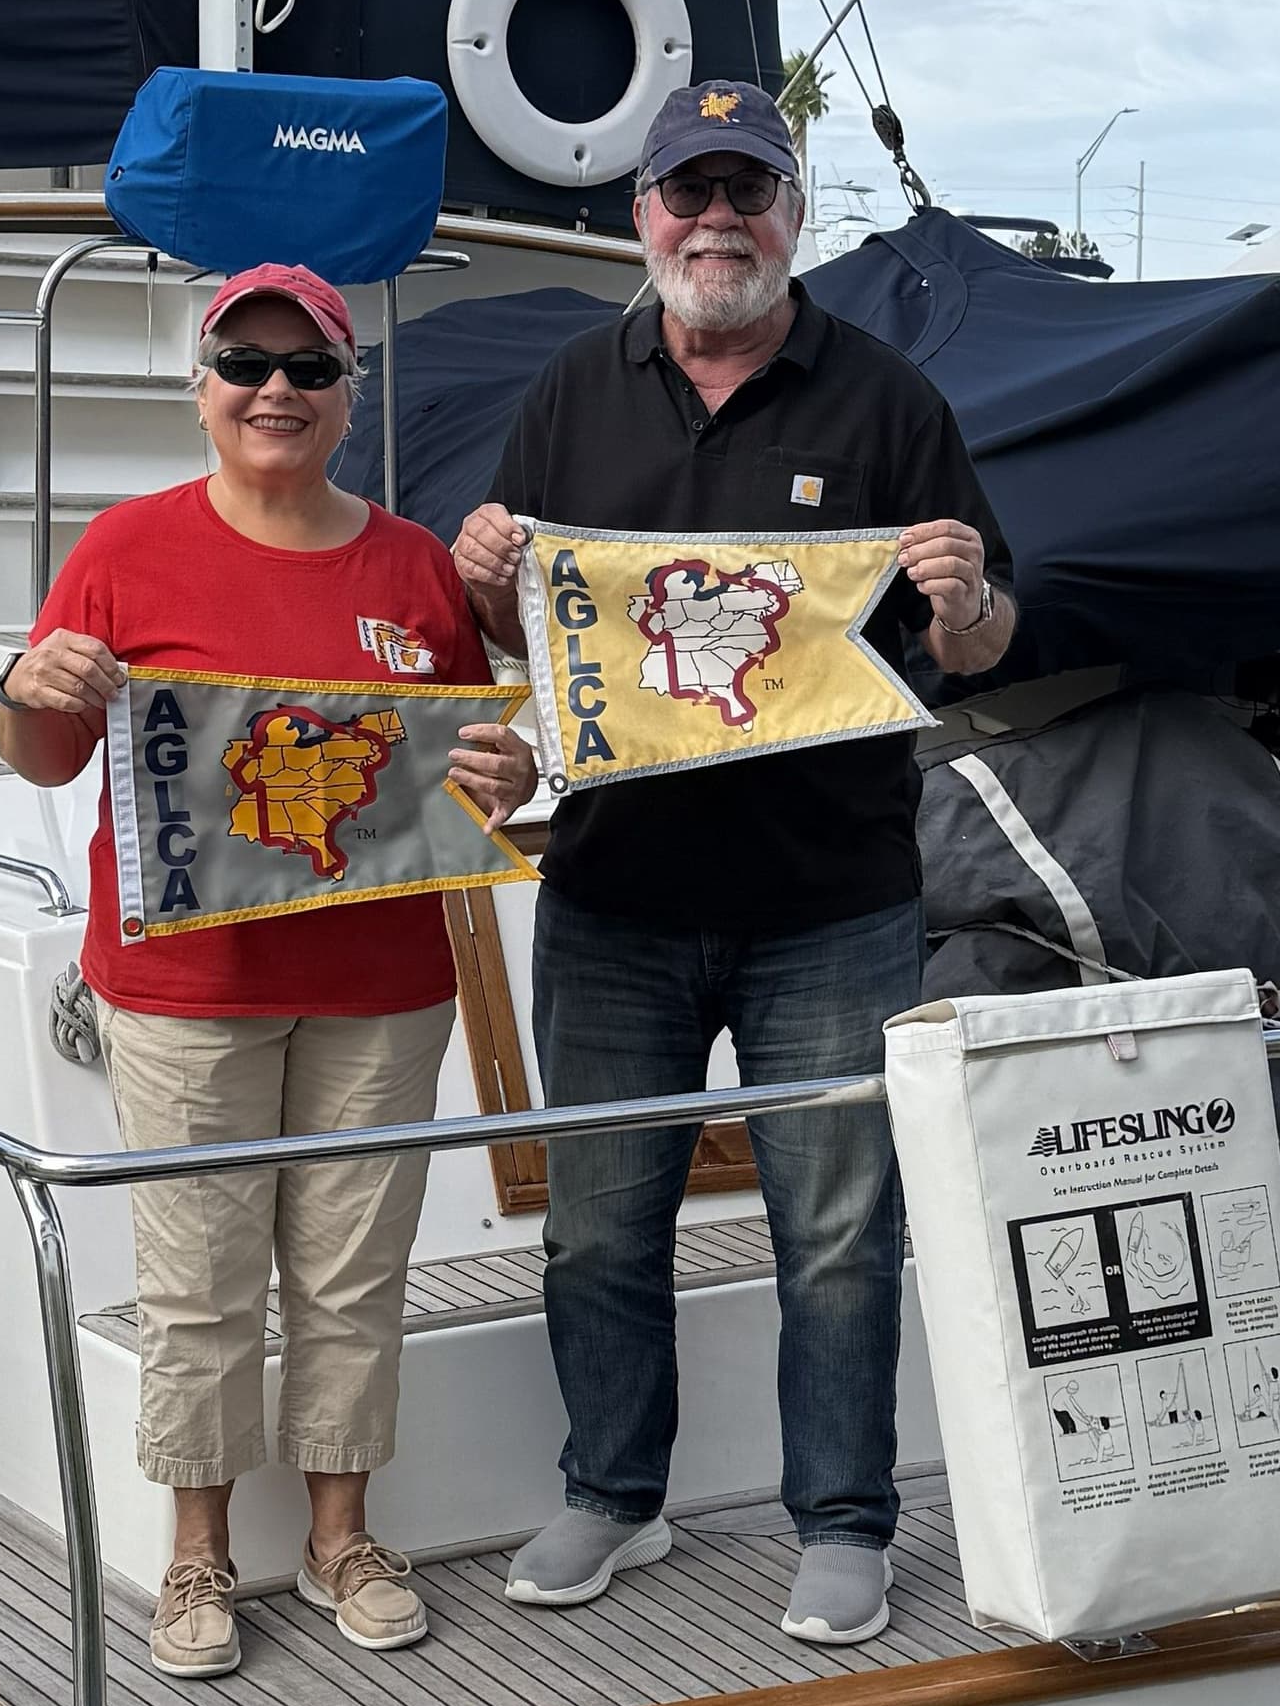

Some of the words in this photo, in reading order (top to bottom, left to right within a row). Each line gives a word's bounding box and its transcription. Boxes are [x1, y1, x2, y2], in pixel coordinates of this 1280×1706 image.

[273, 124, 366, 154] MAGMA
[551, 549, 616, 765] AGLCA
[762, 677, 785, 690] TM
[143, 689, 201, 913] AGLCA
[353, 828, 377, 840] TM
[1052, 1103, 1205, 1155] LIFESLING
[1040, 1156, 1115, 1176] Overboard
[1123, 1149, 1172, 1163] Rescue
[1179, 1141, 1226, 1155] System
[1070, 1180, 1112, 1194] Instruction
[1144, 1173, 1156, 1184] for
[1157, 1167, 1193, 1180] Complete
[1105, 1264, 1121, 1276] OR
